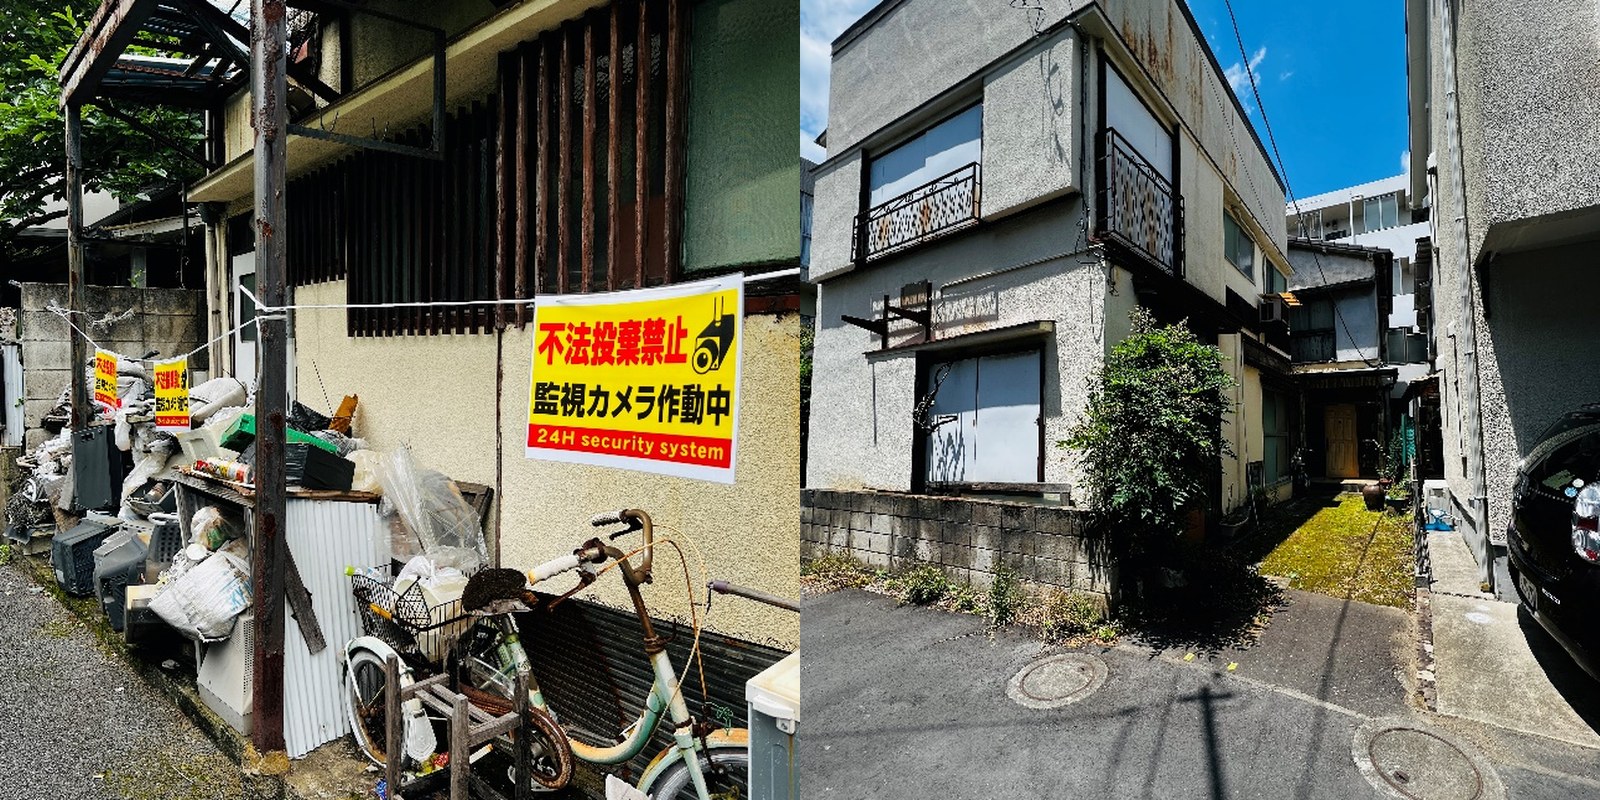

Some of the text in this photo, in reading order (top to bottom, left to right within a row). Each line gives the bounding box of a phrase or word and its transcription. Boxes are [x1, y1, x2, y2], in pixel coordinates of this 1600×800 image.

[538, 315, 688, 366] 不法投棄禁止
[533, 381, 730, 426] 監視カメラ作動中
[537, 428, 723, 460] 24H security system
